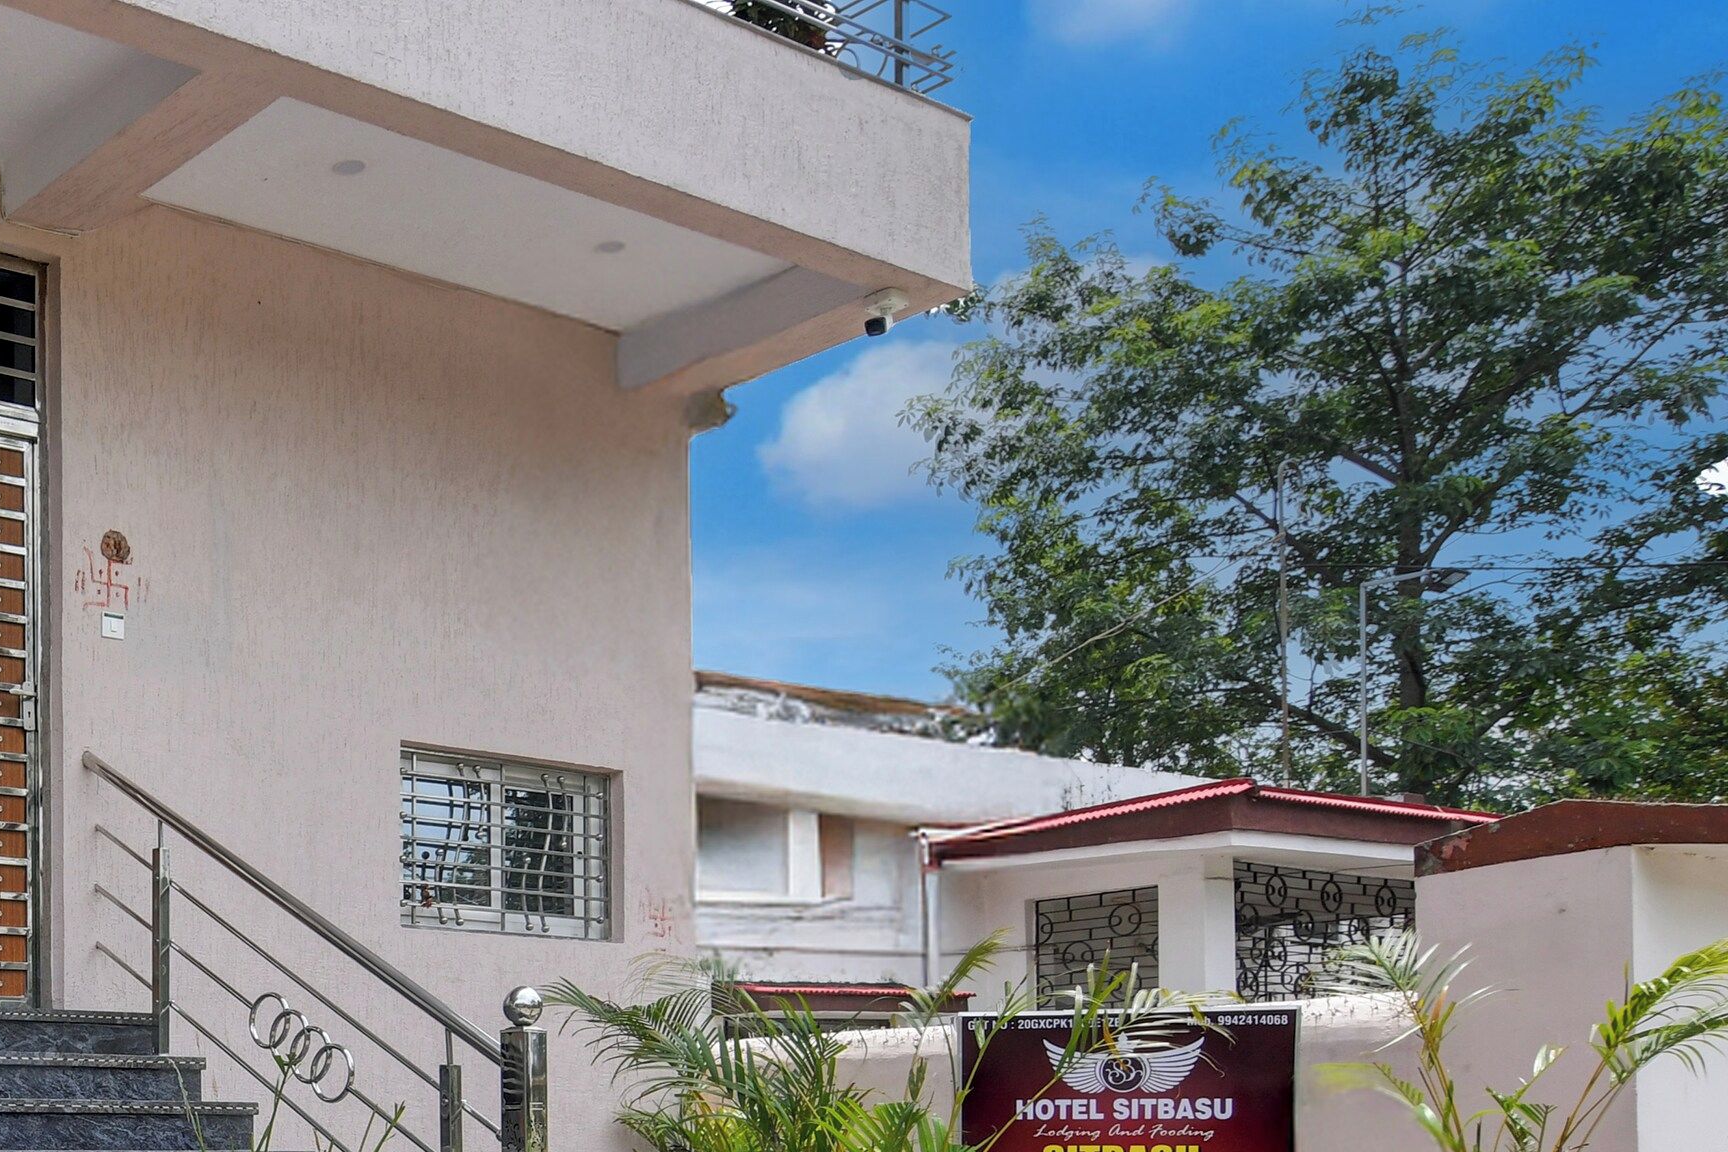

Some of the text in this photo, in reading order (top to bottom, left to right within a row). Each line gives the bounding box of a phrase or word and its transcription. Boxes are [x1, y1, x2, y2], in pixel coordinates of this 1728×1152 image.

[967, 1019, 989, 1031] GT
[1187, 1014, 1288, 1026] Mb. 9942414068
[1015, 1097, 1233, 1120] HOTEL SITBASU
[1033, 1123, 1215, 1142] Lodging And Fooding
